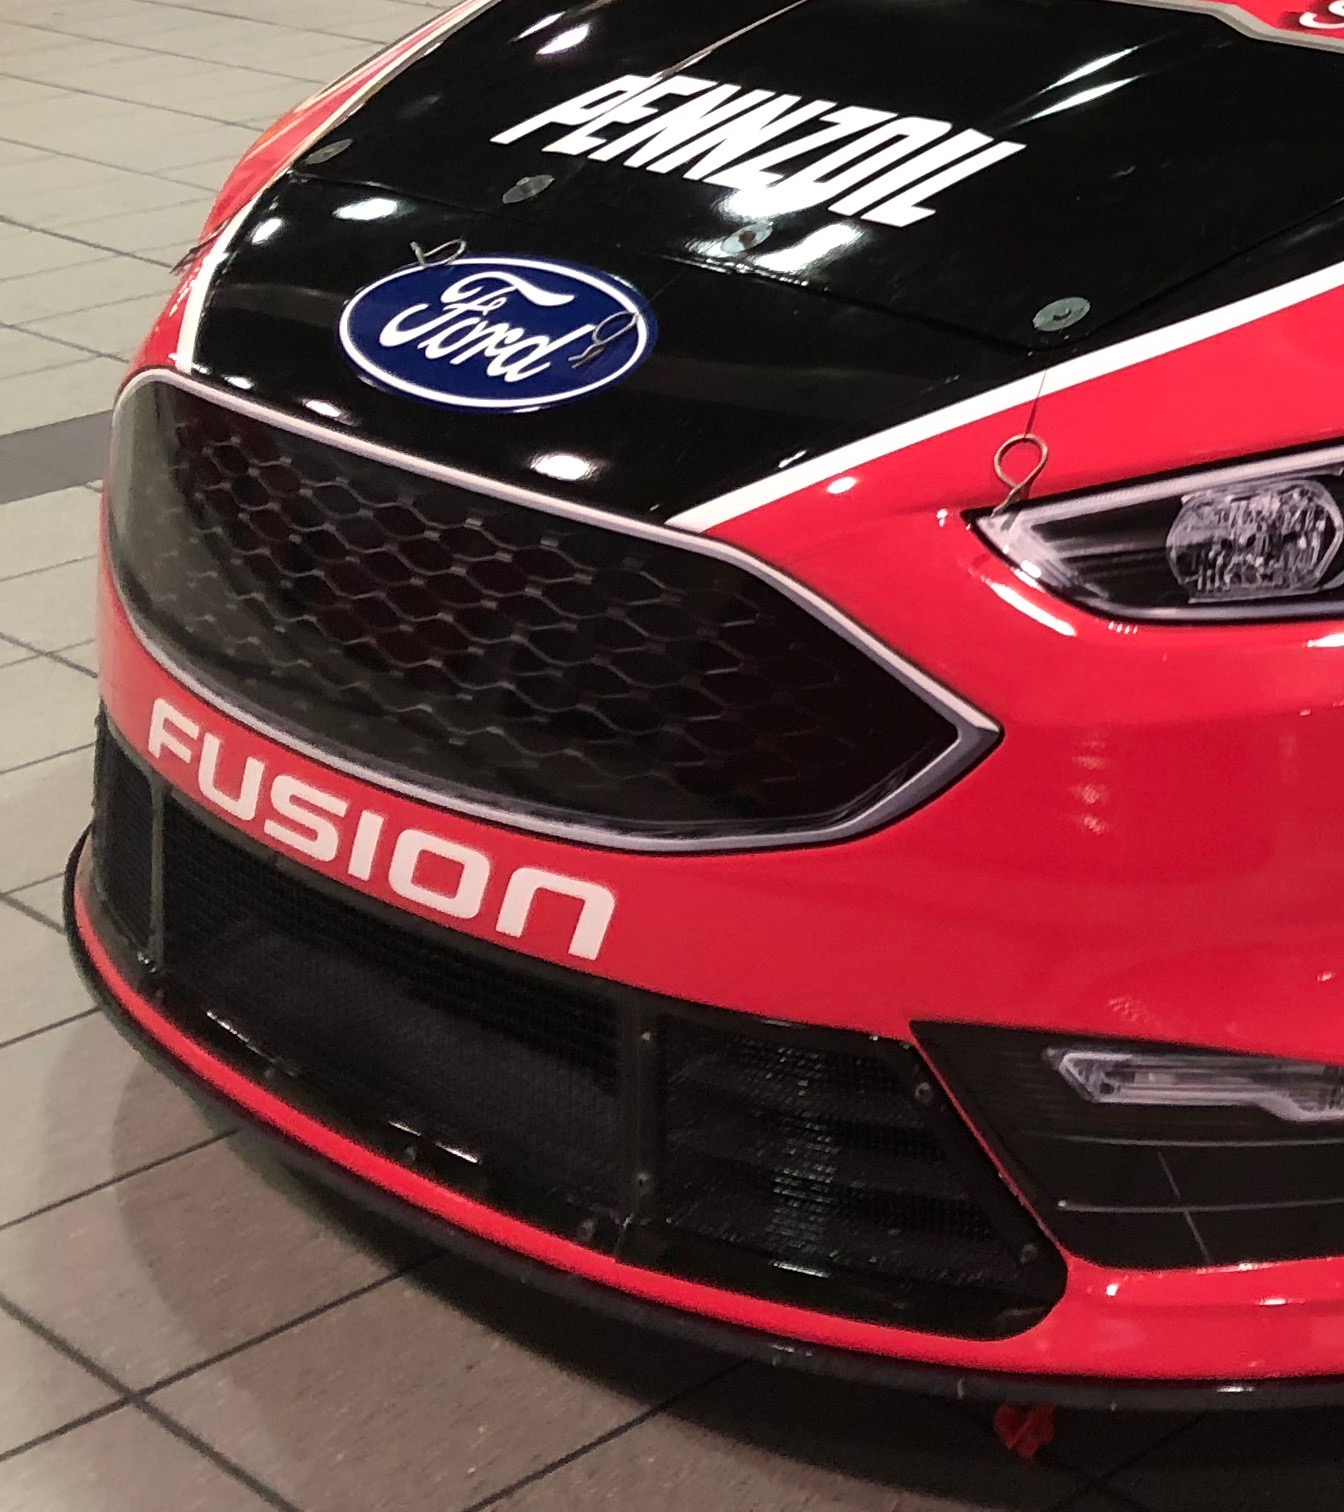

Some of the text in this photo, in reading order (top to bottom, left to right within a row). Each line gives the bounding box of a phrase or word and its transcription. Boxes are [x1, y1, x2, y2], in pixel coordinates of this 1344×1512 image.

[488, 73, 1027, 228] PENNZOIL
[378, 271, 597, 383] Ford
[147, 697, 616, 961] FUSION
